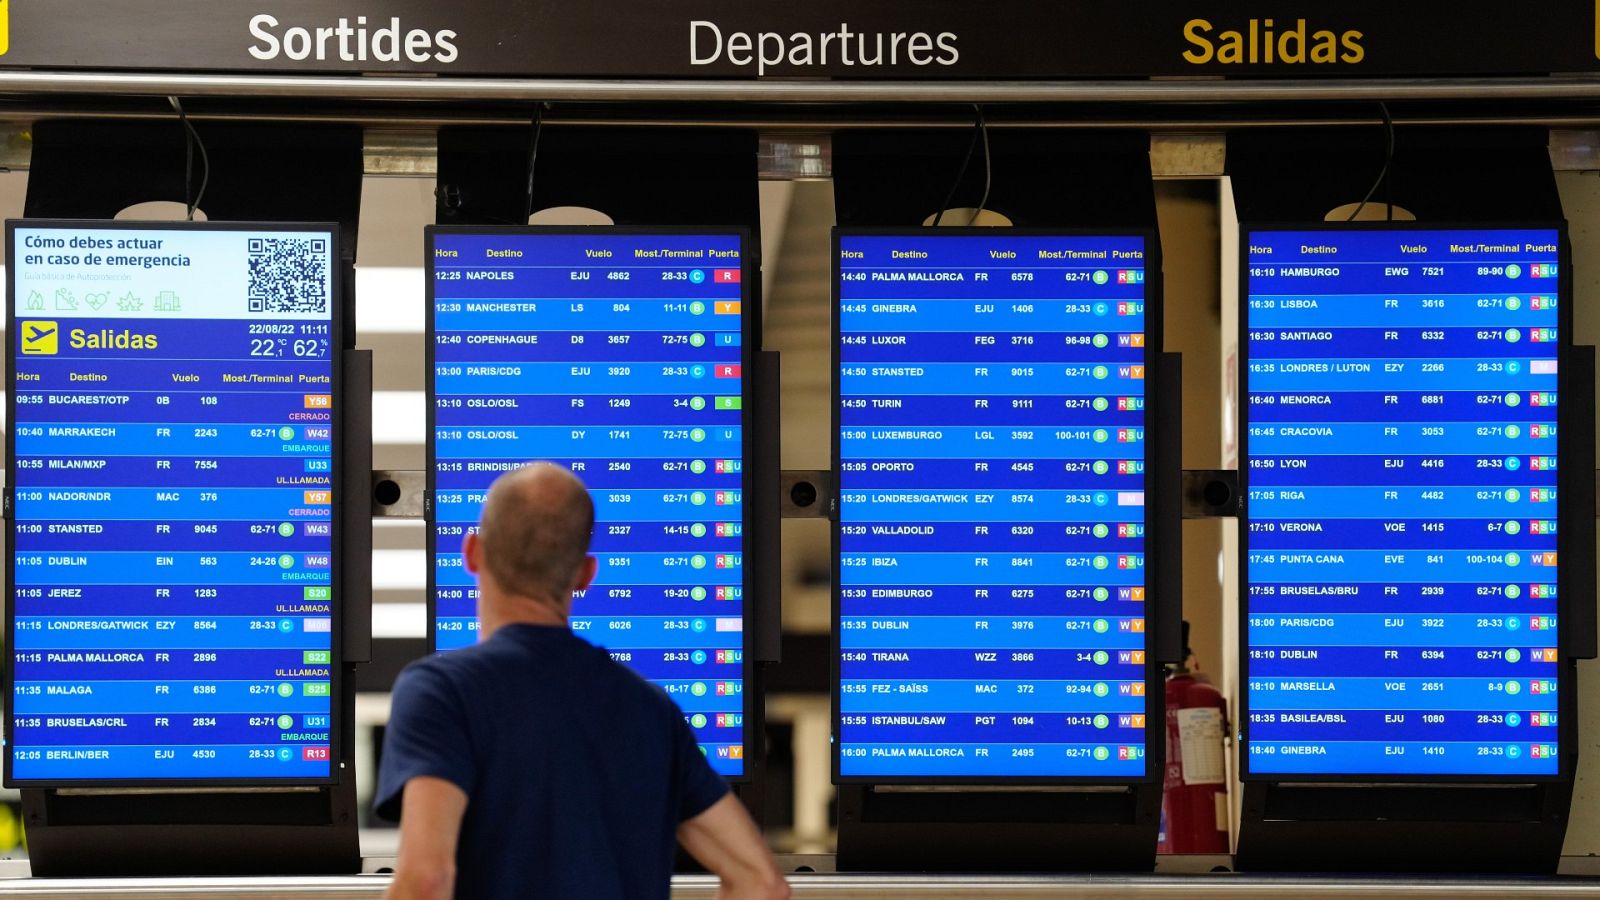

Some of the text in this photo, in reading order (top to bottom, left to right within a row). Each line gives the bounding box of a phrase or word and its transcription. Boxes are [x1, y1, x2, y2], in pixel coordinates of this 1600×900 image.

[247, 13, 459, 63] Sortides
[1182, 18, 1365, 64] Salidas
[689, 20, 960, 76] Departures
[24, 235, 164, 250] Cómo debes actuar
[435, 248, 739, 258] Hora Destino Vuelo Most./Terminal Puerta
[1249, 243, 1557, 254] Hora Destino Vuelo Most./Terminal Puerta
[841, 250, 1143, 259] Hora Destino Vuelo Most./Terminal Puerta
[24, 252, 191, 269] en caso de emergencia
[435, 271, 688, 280] 12:25 NAPOLES EJU 4862 28-33
[841, 272, 1090, 281] 14:40 PALMA MALLORCA FR 6578 62-71
[1249, 298, 1503, 308] 16:30 LISBOA FR 3616 62-71
[248, 324, 328, 335] 22/08/22 11:11
[69, 328, 158, 350] Salidas
[436, 367, 688, 376] 13:00 PARIS/CDG EJU 3920 28-33
[1249, 363, 1275, 372] 16:35
[1280, 363, 1329, 372] LONDRES
[1336, 363, 1371, 372] LUTON
[1384, 363, 1404, 372] EZY
[1422, 363, 1445, 372] 2266
[1477, 363, 1503, 372] 28-33
[16, 372, 330, 383] Hora Destino Vuelo Most./Terminal Puerta
[16, 395, 44, 404] 09:55
[48, 395, 130, 405] BUCAREST/OTP
[200, 396, 218, 405] 108
[288, 412, 331, 421] CERRADO
[16, 427, 328, 438] 10:40 MARRAKECH FR 2243 62-71 W42
[436, 430, 688, 440] 13:10 OSLO/OSL DY 1741 72-75
[841, 431, 1090, 440] 15:00 LUXEMBURGO LGL 3592 100-101
[282, 444, 330, 453] EMBARQUE
[437, 494, 688, 503] 13:25 PRA 3039 62-71
[841, 526, 1090, 535] 15:20 VALLADOLID FR 6320 62-71
[1249, 555, 1503, 564] 17:45 PUNTA CANA EVE 841 100-104
[841, 589, 1090, 598] 15:30 EDIMBURGO FR 6275 62-71
[15, 621, 276, 630] 11:15 LONDRES/GATWICK EZY 8564 28-33
[437, 621, 463, 631] 14:20
[572, 621, 592, 630] EZY
[609, 621, 632, 630] 6026
[663, 621, 689, 630] 28-33
[1249, 650, 1502, 659] 18:10 DUBLIN FR 6394 62-71
[15, 686, 41, 695] 11:35
[47, 686, 93, 695] MALAGA
[155, 685, 169, 694] FR
[193, 685, 217, 695] 6386
[249, 685, 275, 694] 62-71
[841, 684, 867, 693] 15:55
[872, 684, 891, 693] FEZ
[899, 682, 929, 693] SAÏSS
[975, 684, 997, 693] MAC
[1016, 684, 1034, 693] 372
[1066, 684, 1091, 693] 92-94
[1249, 714, 1503, 724] 18:35 BASILEA/BSL EJU 1080 28-33
[14, 749, 326, 760] 12:05 BERLIN/BER EJU 4530 28-33 R13
